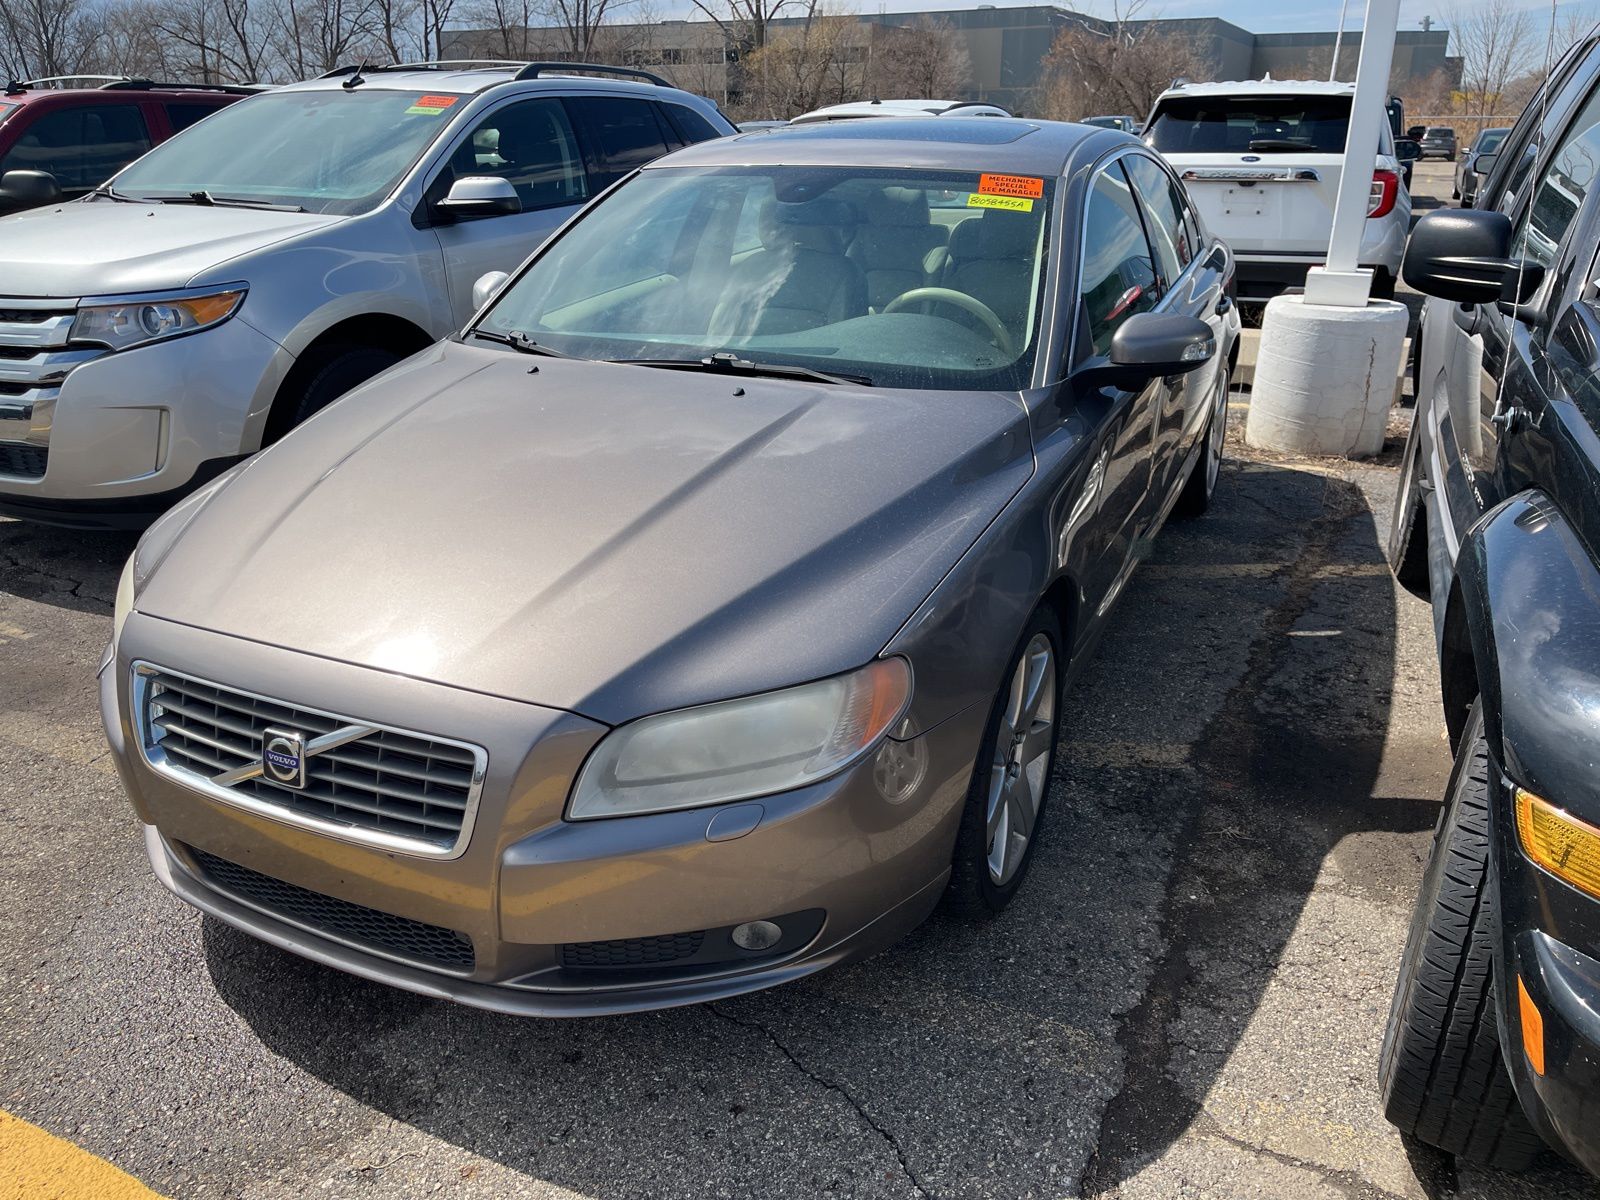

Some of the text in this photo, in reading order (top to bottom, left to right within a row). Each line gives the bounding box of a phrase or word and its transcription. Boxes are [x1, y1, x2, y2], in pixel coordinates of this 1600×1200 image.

[988, 176, 1036, 185] MECHANICS
[998, 187, 1040, 196] MANAGER
[268, 753, 297, 766] VOLVO
